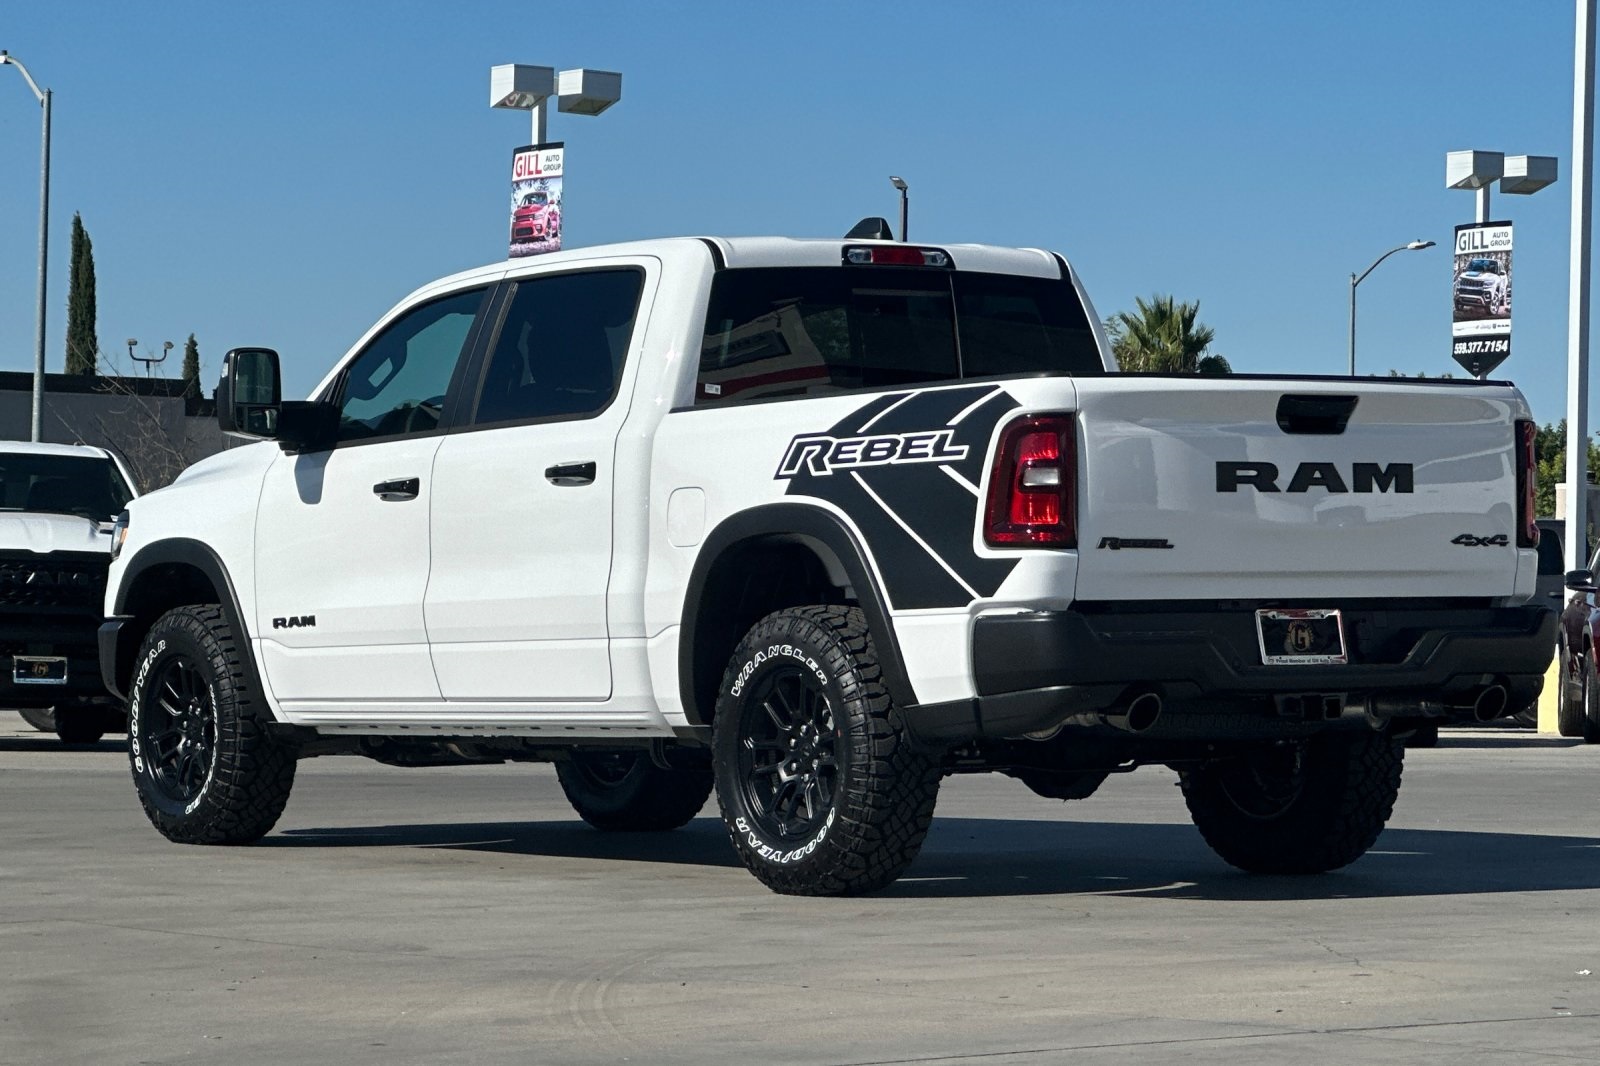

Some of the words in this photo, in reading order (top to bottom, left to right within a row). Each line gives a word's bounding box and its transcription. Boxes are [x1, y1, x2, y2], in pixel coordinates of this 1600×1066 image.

[515, 154, 542, 177] GILL
[545, 154, 560, 162] AUTO
[1458, 231, 1489, 251] GILL
[1492, 231, 1509, 239] AUTO
[1454, 340, 1508, 354] 559.377.7154
[778, 429, 970, 477] REBEL
[1215, 461, 1415, 494] RAM
[272, 615, 317, 630] RAM
[731, 644, 828, 697] WRANGLER
[131, 639, 167, 774] GOODYEAR
[735, 806, 836, 864] GOODYEAR
